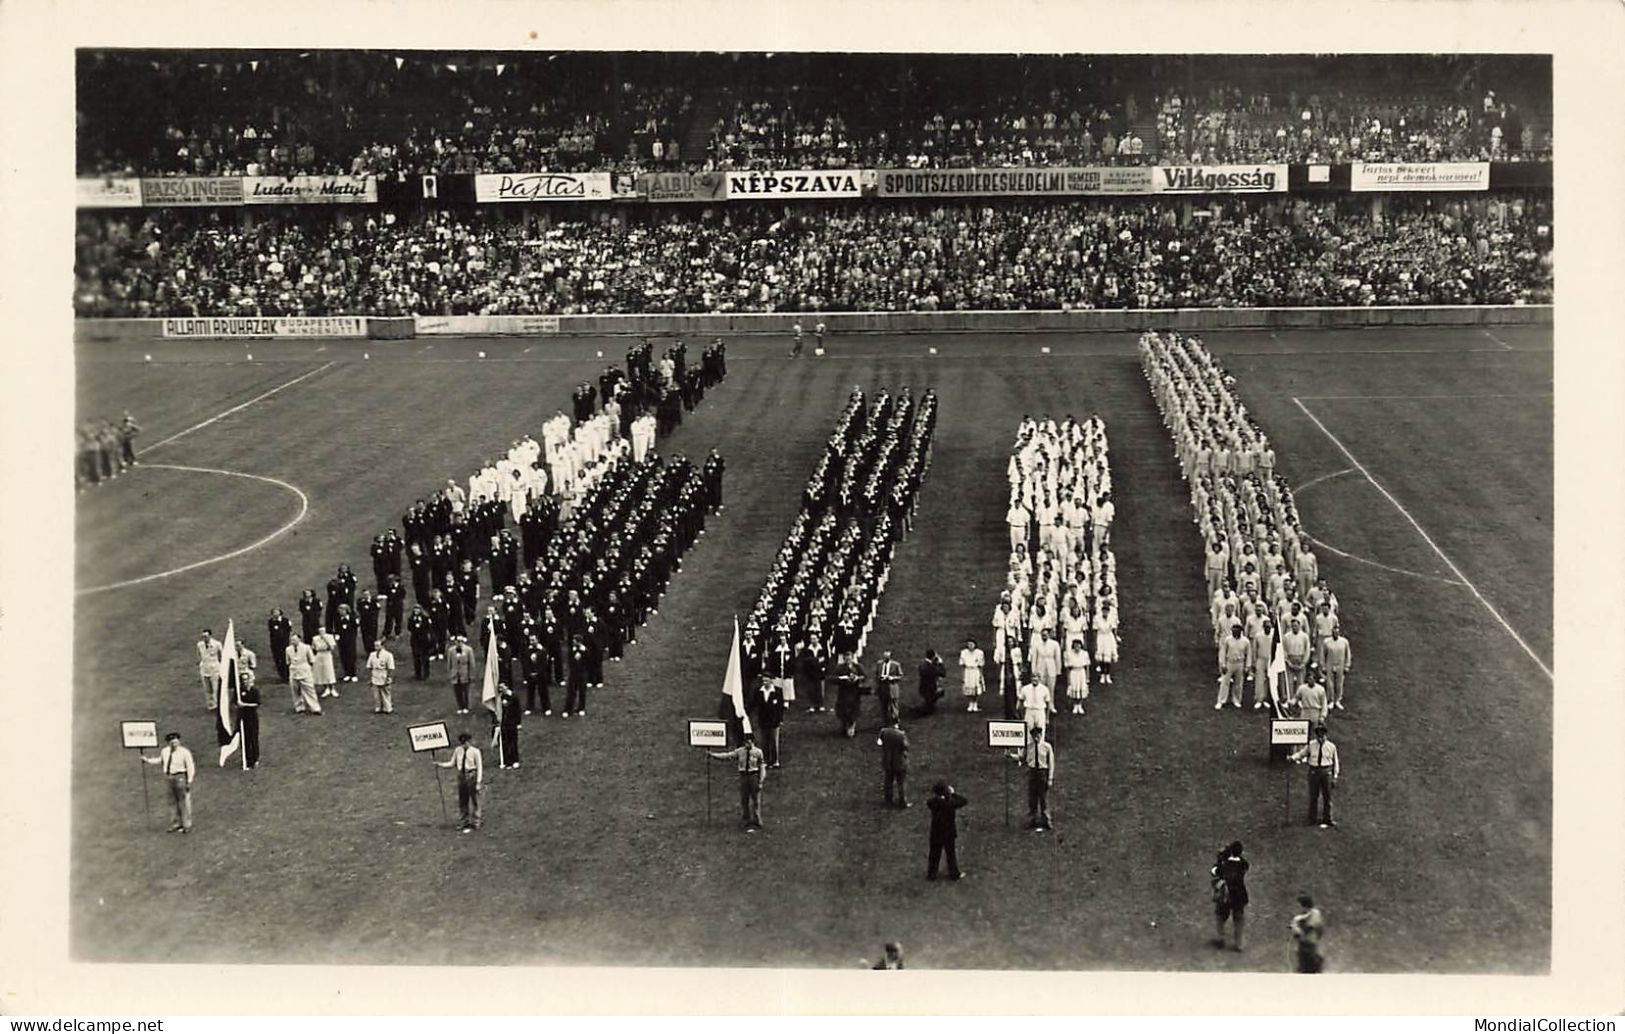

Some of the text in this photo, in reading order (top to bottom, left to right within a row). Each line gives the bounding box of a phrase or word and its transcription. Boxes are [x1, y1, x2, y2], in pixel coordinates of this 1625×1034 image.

[192, 180, 219, 196] ING
[730, 172, 859, 193] NÉPSZAVA
[1162, 167, 1276, 191] Világosság
